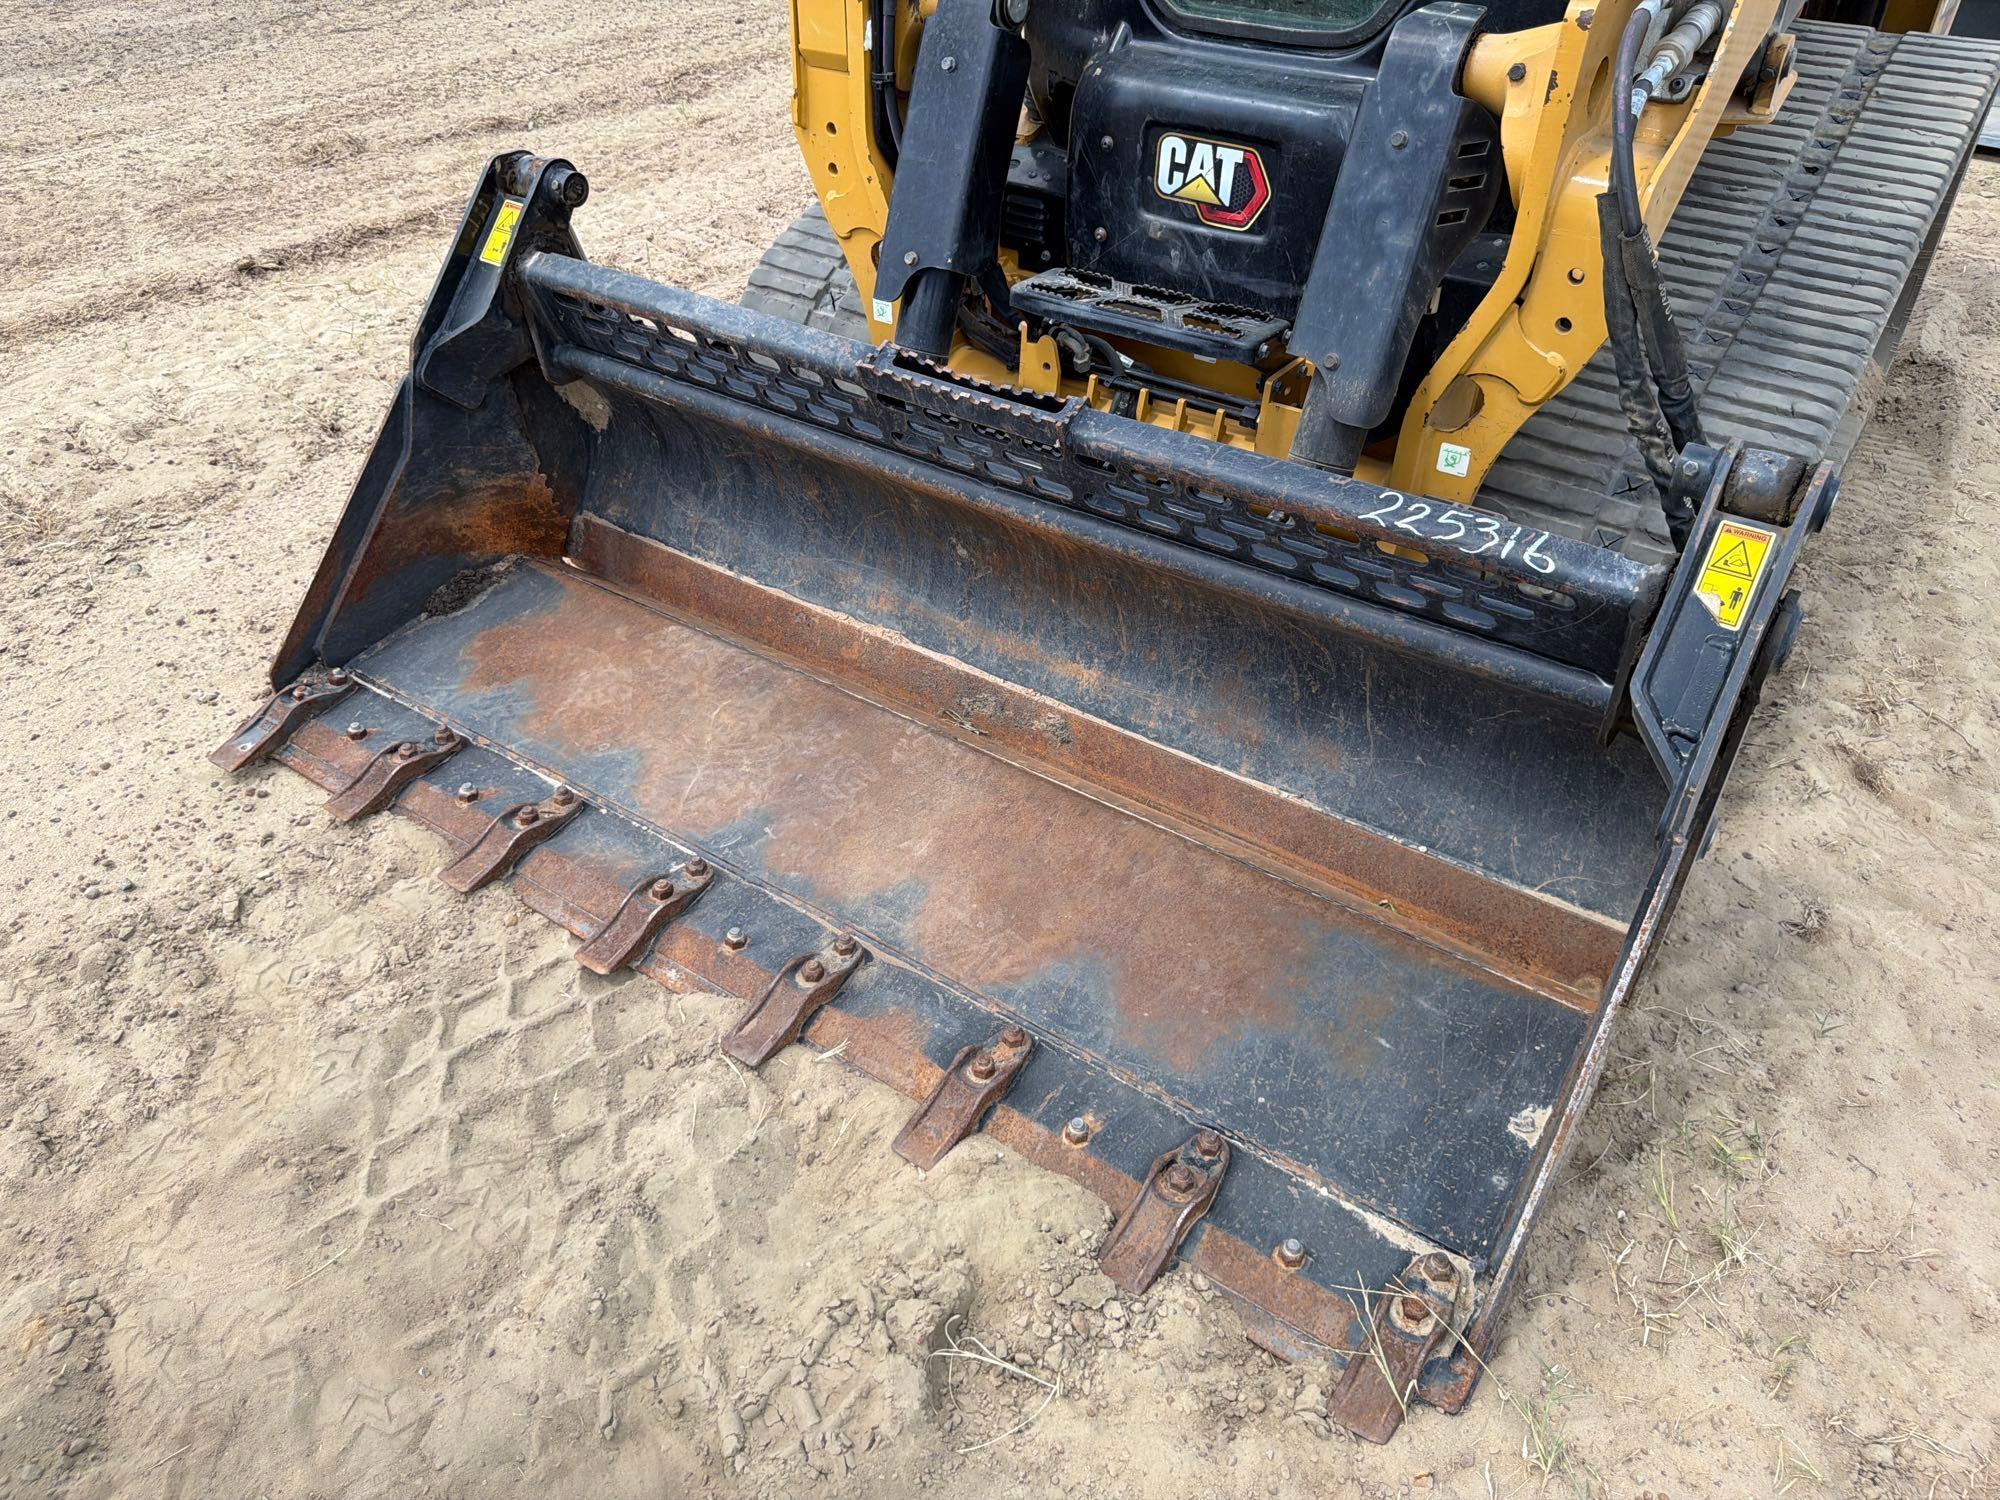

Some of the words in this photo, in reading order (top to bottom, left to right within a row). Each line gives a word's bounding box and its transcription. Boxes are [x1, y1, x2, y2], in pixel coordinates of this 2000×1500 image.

[1158, 136, 1244, 207] CAT
[1358, 491, 1556, 574] 225316
[1733, 528, 1768, 542] WARNING
